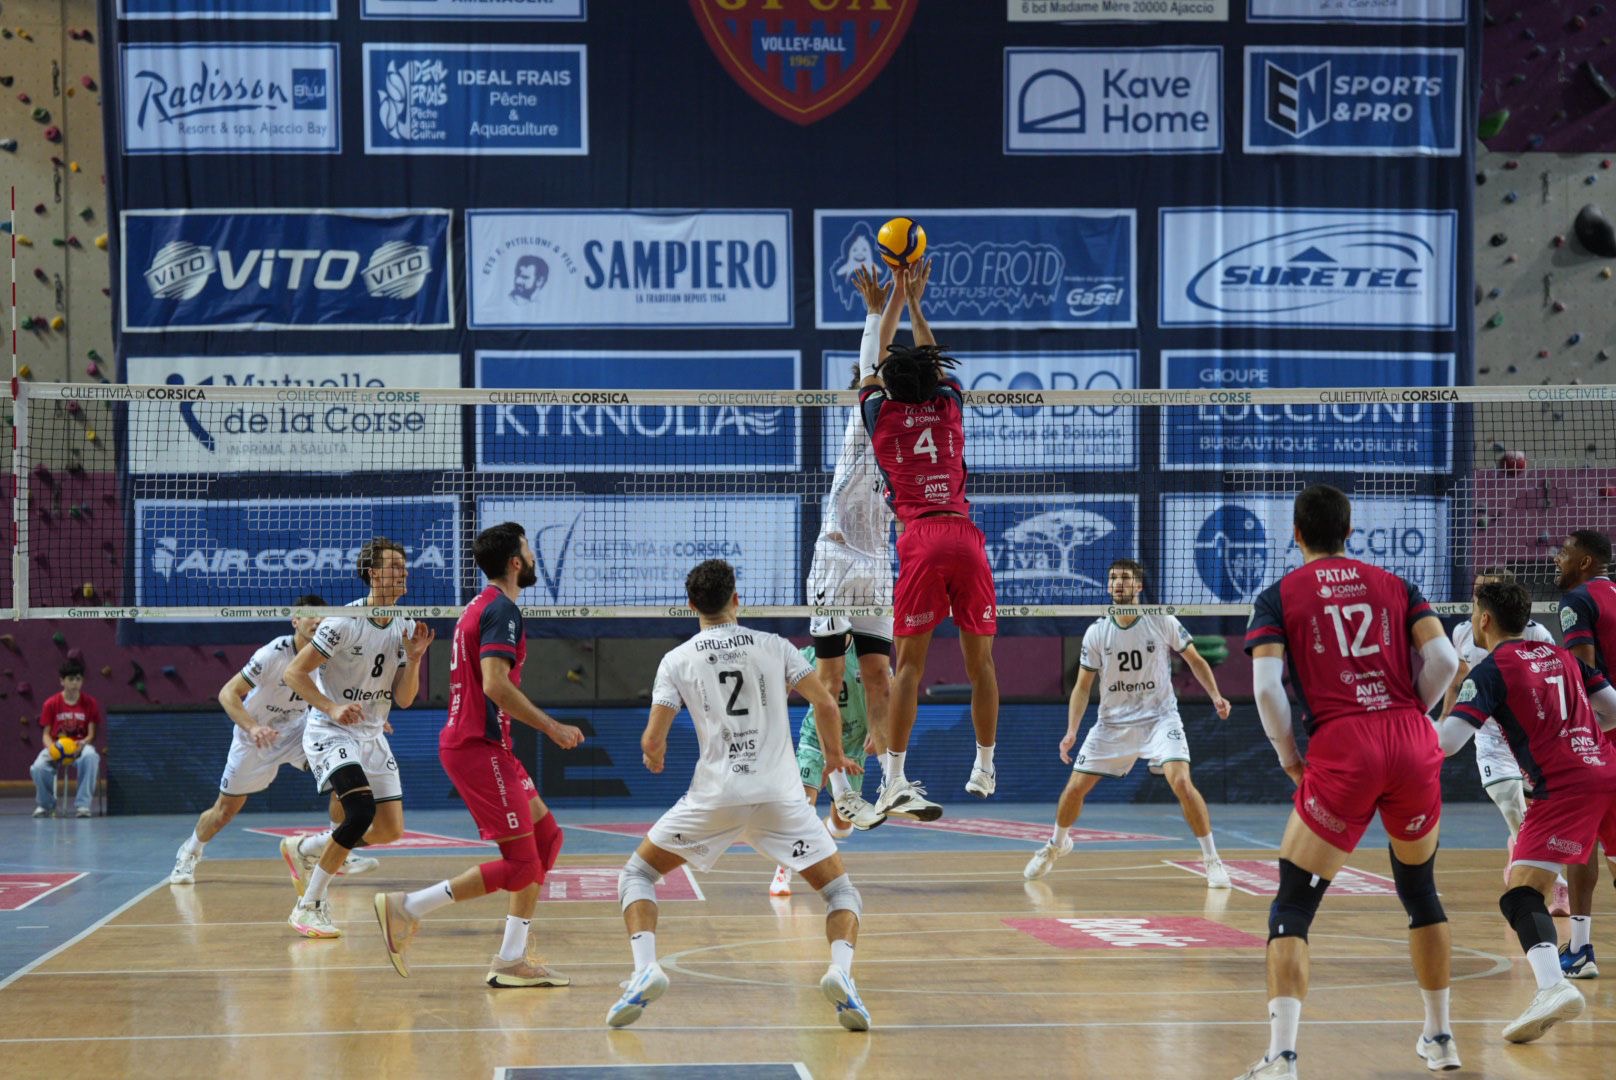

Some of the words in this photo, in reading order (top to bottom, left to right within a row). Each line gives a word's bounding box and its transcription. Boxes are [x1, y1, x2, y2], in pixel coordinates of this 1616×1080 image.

[1032, 1, 1047, 14] bd
[1051, 1, 1099, 13] Madame
[1132, 1, 1167, 13] 20000
[1170, 1, 1214, 15] Ajaccio
[761, 37, 847, 51] VOLLEY-BALL
[457, 70, 512, 85] IDEAL
[516, 70, 571, 86] FRAIS
[1103, 68, 1191, 100] Kave
[1333, 75, 1443, 97] SPORTS
[135, 61, 288, 130] Radisson
[410, 84, 448, 107] FRAIS
[490, 91, 538, 107] Pêche
[508, 109, 519, 121] &
[1103, 103, 1210, 134] Home
[1333, 102, 1413, 123] &PRO
[178, 122, 215, 135] Resort
[220, 122, 228, 134] &
[260, 122, 302, 137] Ajaccio
[307, 122, 327, 137] Bay
[469, 121, 560, 139] Aquaculture
[583, 239, 777, 291] SAMPIERO
[981, 250, 1061, 287] FROID
[1221, 265, 1422, 288] SURETEC
[929, 286, 1023, 299] DIFFUSION
[1066, 287, 1124, 306] Gasel
[1199, 368, 1269, 383] GROUPE
[146, 388, 206, 400] CORSICA
[376, 391, 420, 402] CORSE
[572, 393, 629, 404] CORSICA
[795, 393, 838, 404] CORSE
[987, 393, 1044, 404] CORSICA
[1209, 392, 1252, 403] CORSE
[1402, 390, 1459, 402] CORSICA
[224, 408, 268, 434] de
[280, 408, 314, 434] la
[325, 407, 425, 434] Corse
[495, 403, 749, 437] KYRNOLIA
[914, 415, 941, 424] FORMA
[913, 427, 938, 464] 4
[1200, 436, 1318, 452] BUREAUTIQUE
[1333, 437, 1419, 453] MOBILIER
[924, 482, 948, 494] AVIS
[673, 542, 743, 557] CORSICA
[177, 550, 247, 573] AIR
[255, 545, 445, 573] CORSA
[1315, 567, 1360, 583] PATAK
[1332, 583, 1367, 594] FORMA
[68, 608, 99, 617] Gamm
[103, 608, 125, 617] vert
[221, 607, 252, 617] Gamm
[256, 608, 277, 617] vert
[372, 607, 403, 617] Gamm
[407, 608, 428, 617] vert
[521, 607, 551, 617] Gamm
[556, 608, 576, 617] vert
[815, 606, 845, 616] Gamm
[850, 607, 870, 616] vert
[996, 606, 1016, 616] vert
[1108, 606, 1138, 616] Gamm
[1142, 606, 1162, 615] vert
[1435, 604, 1456, 613] vert
[1324, 603, 1380, 658] 12
[695, 634, 754, 652] GROGNON
[371, 653, 385, 678] 8
[1118, 650, 1142, 672] 20
[719, 670, 749, 716] 2
[1108, 680, 1155, 693] alterna
[1356, 681, 1387, 697] AVIS
[1545, 675, 1568, 721] 7
[729, 740, 755, 753] AVIS
[1570, 736, 1595, 747] AVIS
[338, 748, 347, 759] 8
[1484, 765, 1491, 777] 9
[506, 812, 519, 829] 6
